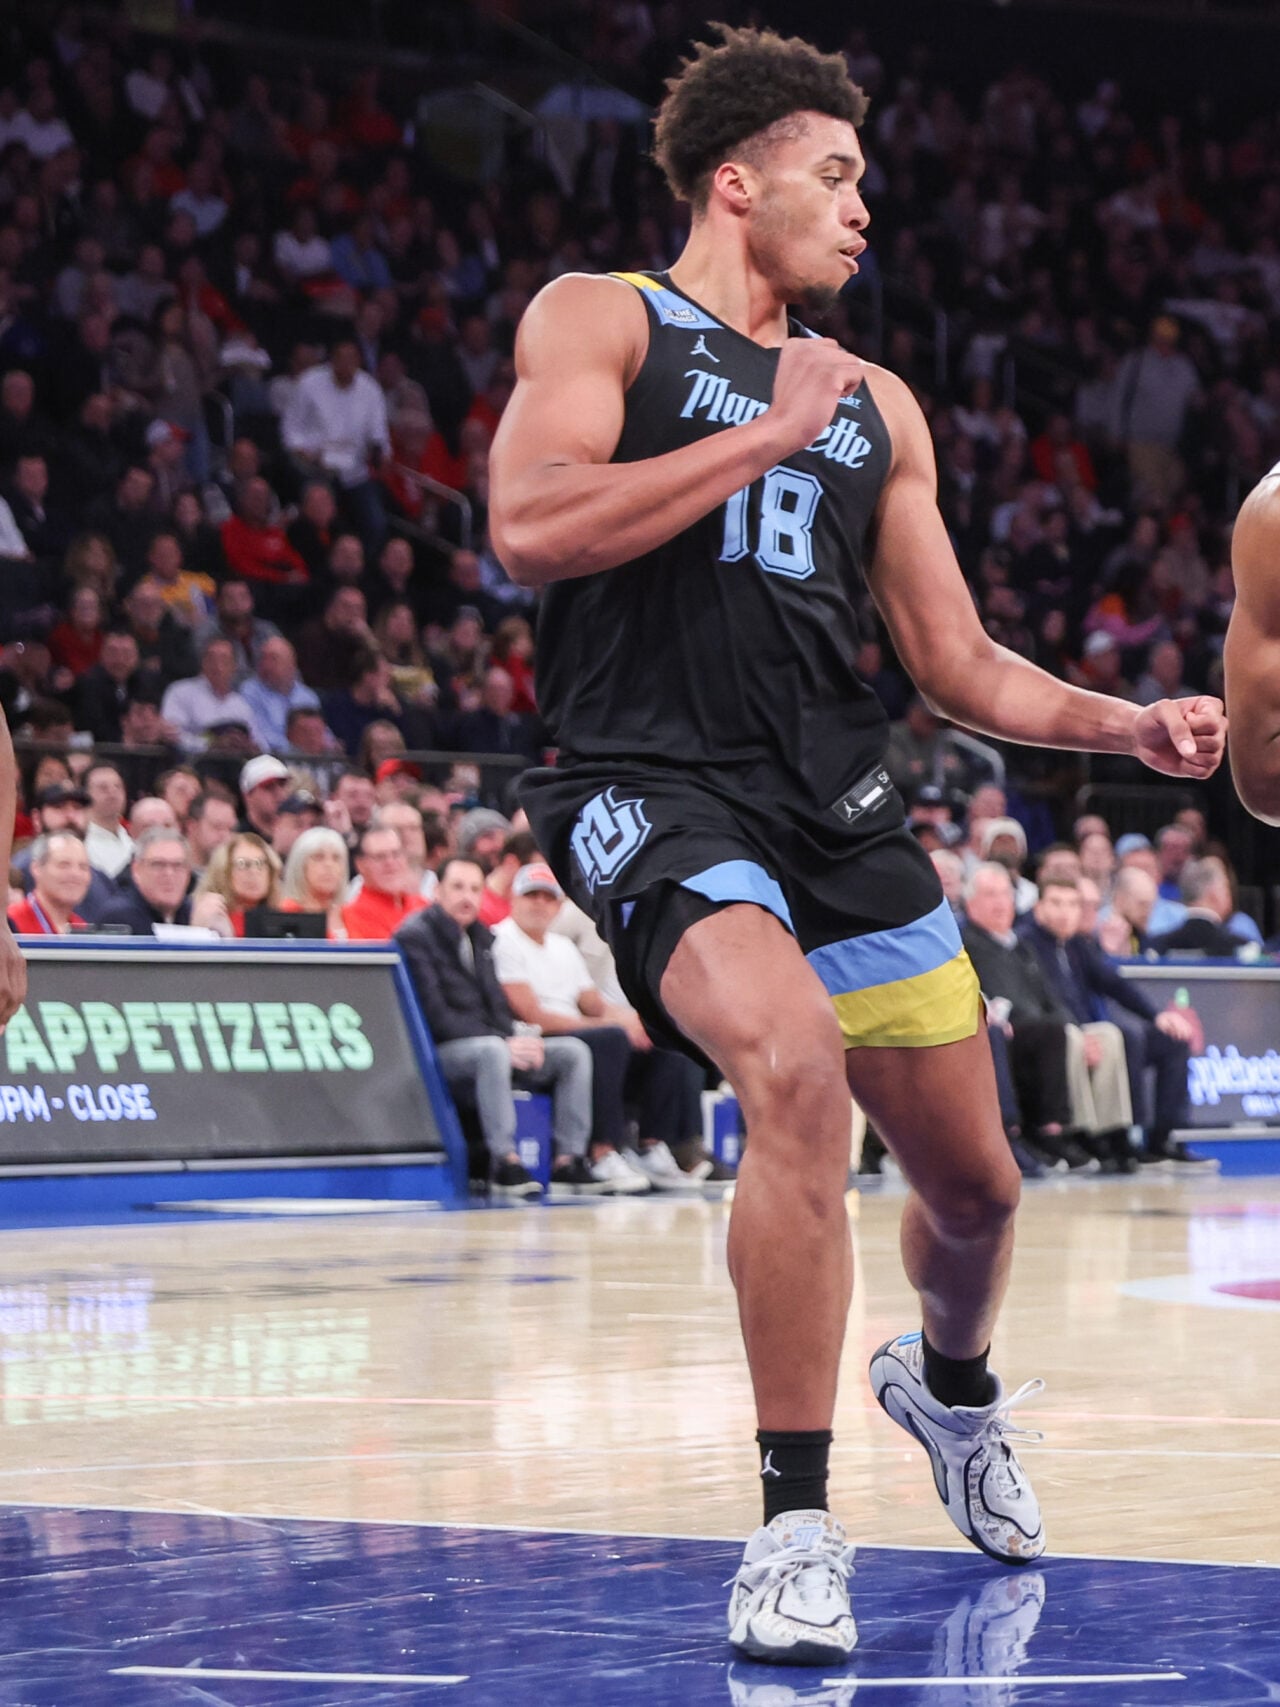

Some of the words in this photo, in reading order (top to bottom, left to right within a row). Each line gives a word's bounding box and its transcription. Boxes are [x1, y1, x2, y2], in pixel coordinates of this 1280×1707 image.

[719, 465, 824, 580] 18
[6, 1002, 375, 1073] APPETIZERS
[0, 1085, 52, 1122] PM
[67, 1084, 157, 1121] CLOSE
